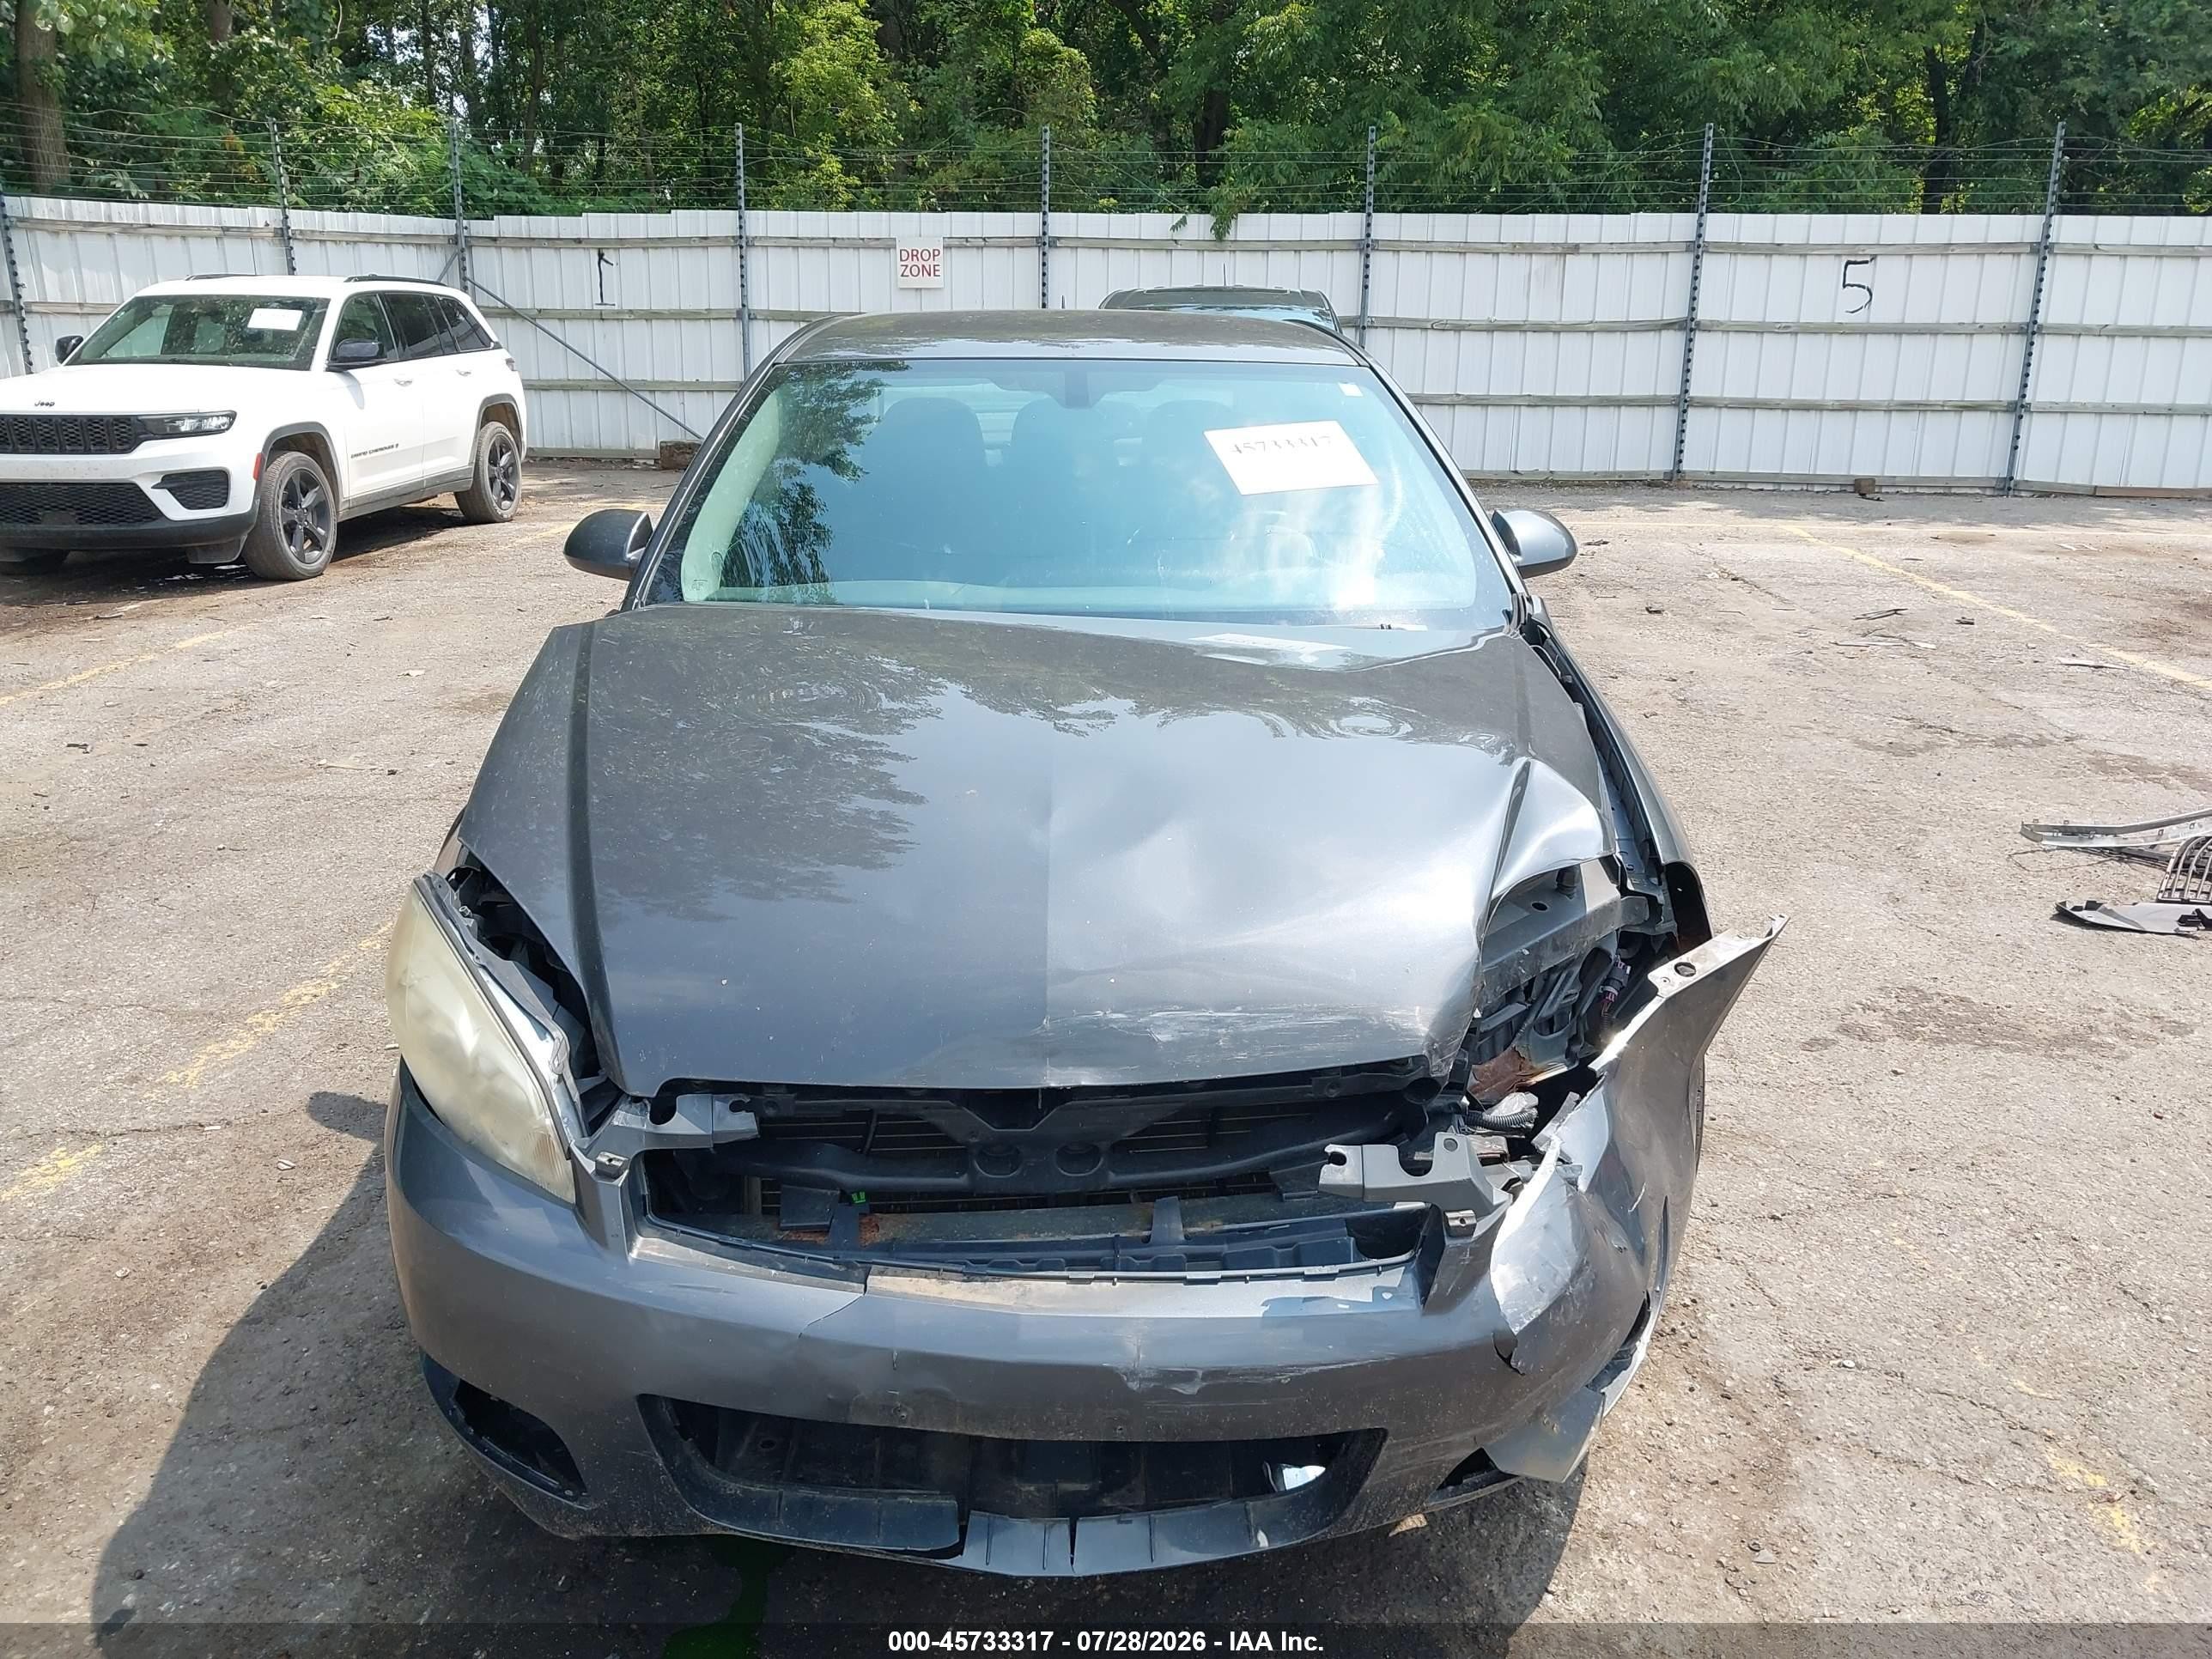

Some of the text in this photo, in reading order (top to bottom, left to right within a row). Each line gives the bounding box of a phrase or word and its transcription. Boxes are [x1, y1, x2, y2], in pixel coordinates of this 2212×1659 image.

[899, 248, 940, 262] DROP
[900, 264, 941, 277] ZONE
[1842, 254, 1875, 313] 5
